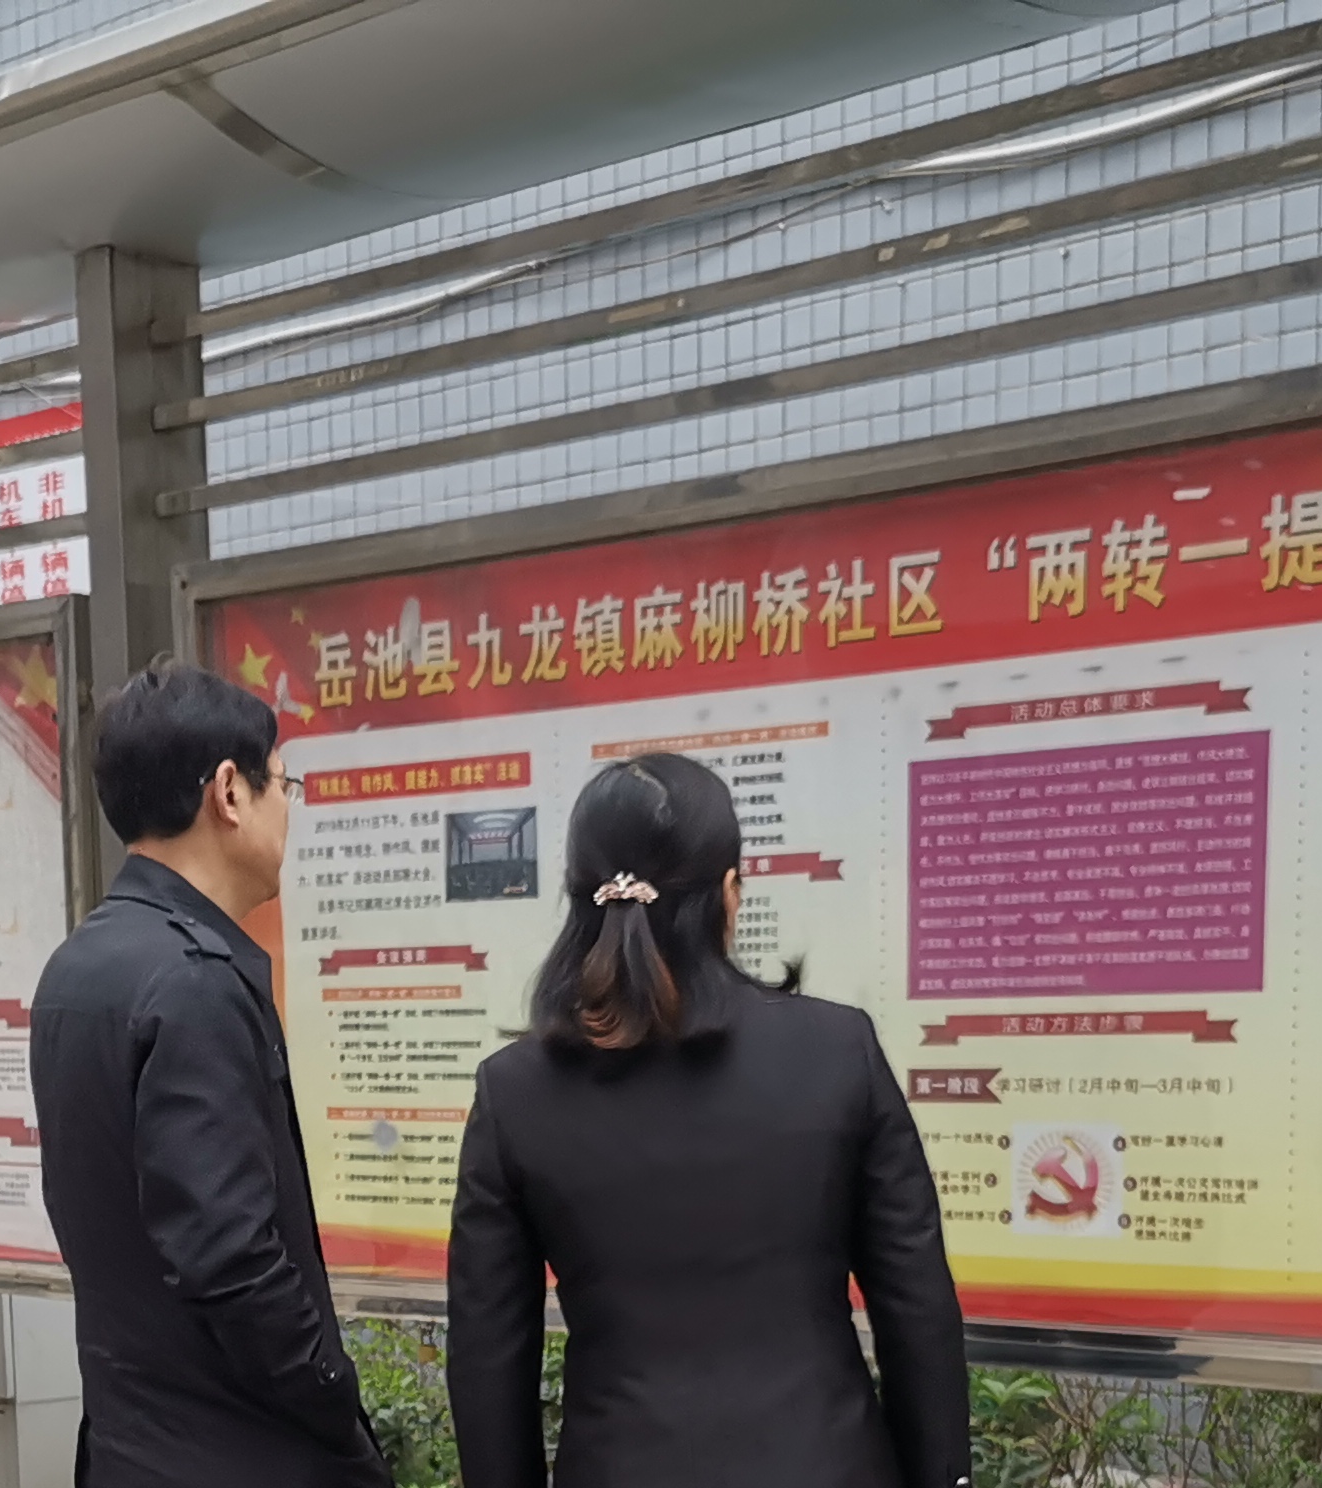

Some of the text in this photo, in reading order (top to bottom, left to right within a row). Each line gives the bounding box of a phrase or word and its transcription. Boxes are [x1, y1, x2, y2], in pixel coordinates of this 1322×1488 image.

[1010, 692, 1155, 721] 活动总体要求
[1002, 1014, 1144, 1033] 活动方法步骤
[915, 1077, 981, 1095] 第一阶段
